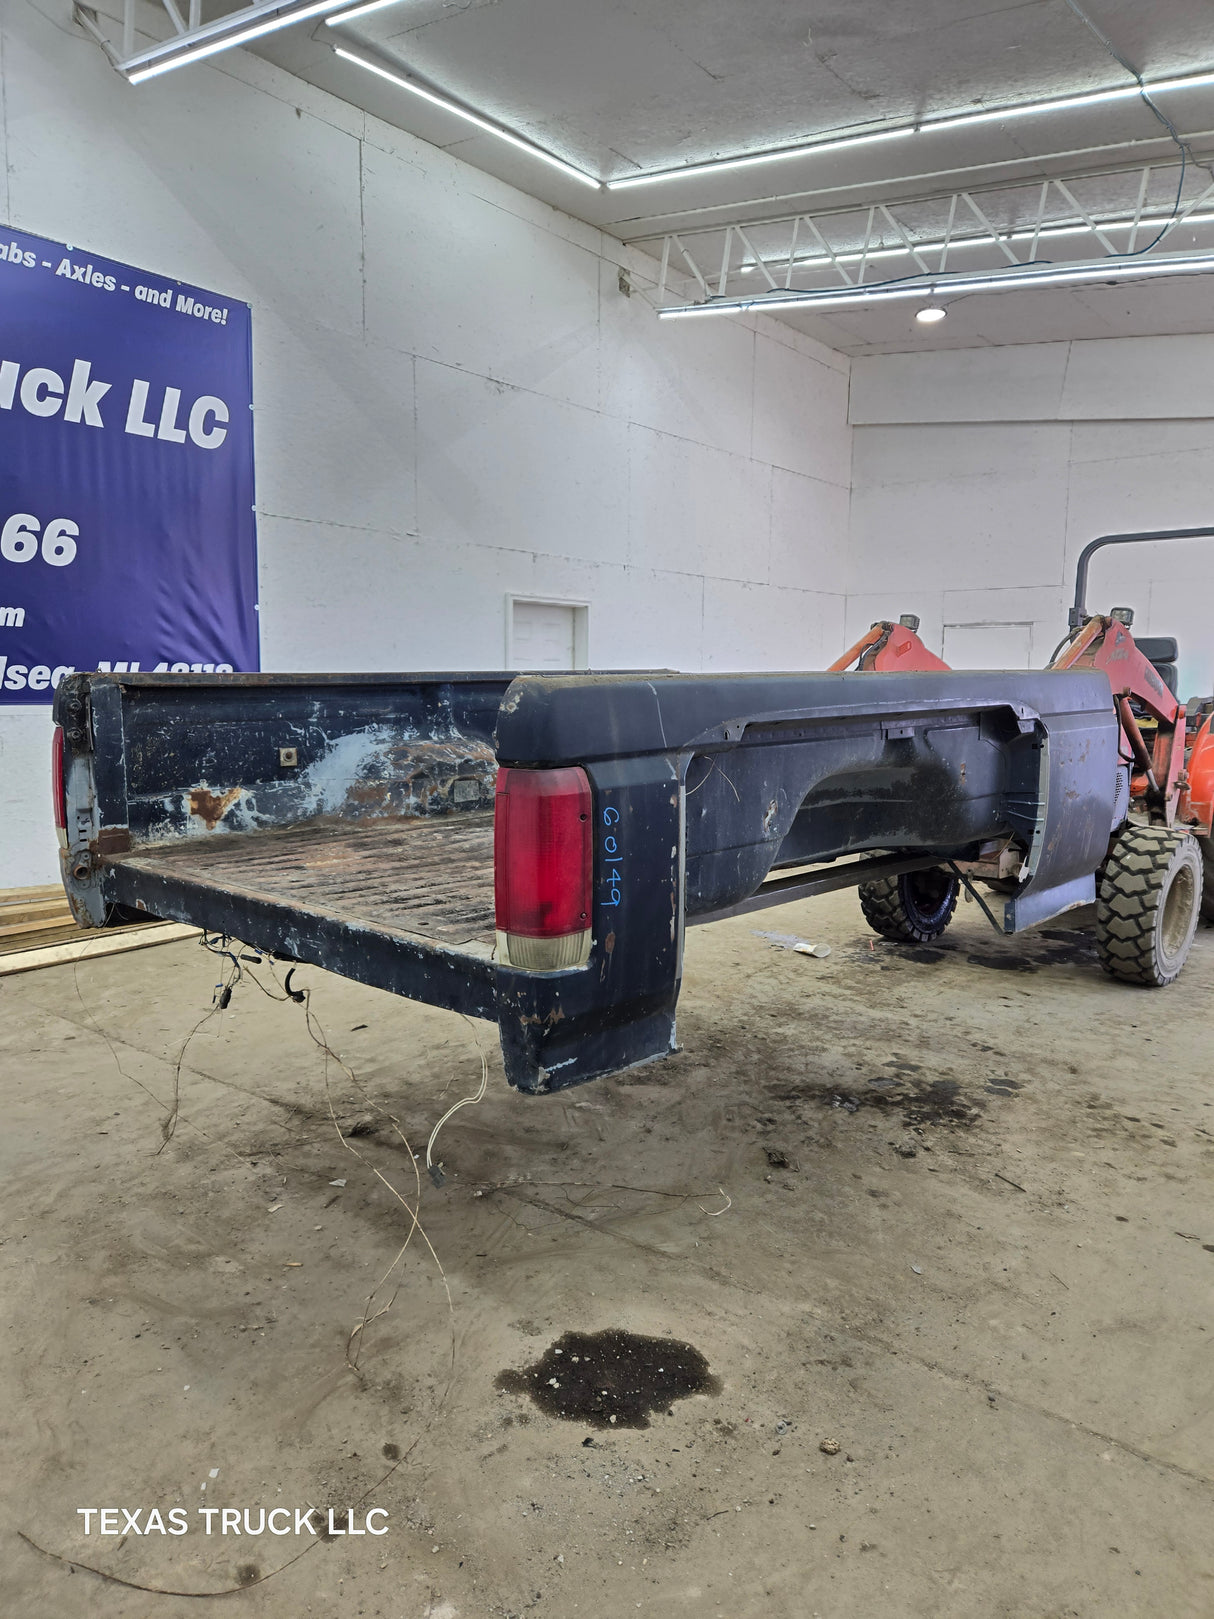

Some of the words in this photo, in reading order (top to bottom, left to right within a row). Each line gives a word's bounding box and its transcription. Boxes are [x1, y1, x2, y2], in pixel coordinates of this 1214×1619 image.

[55, 258, 117, 292] Axles
[134, 285, 173, 308] and
[175, 294, 229, 325] More!
[124, 378, 230, 449] LLC
[0, 513, 80, 567] 66
[600, 807, 623, 907] 60149
